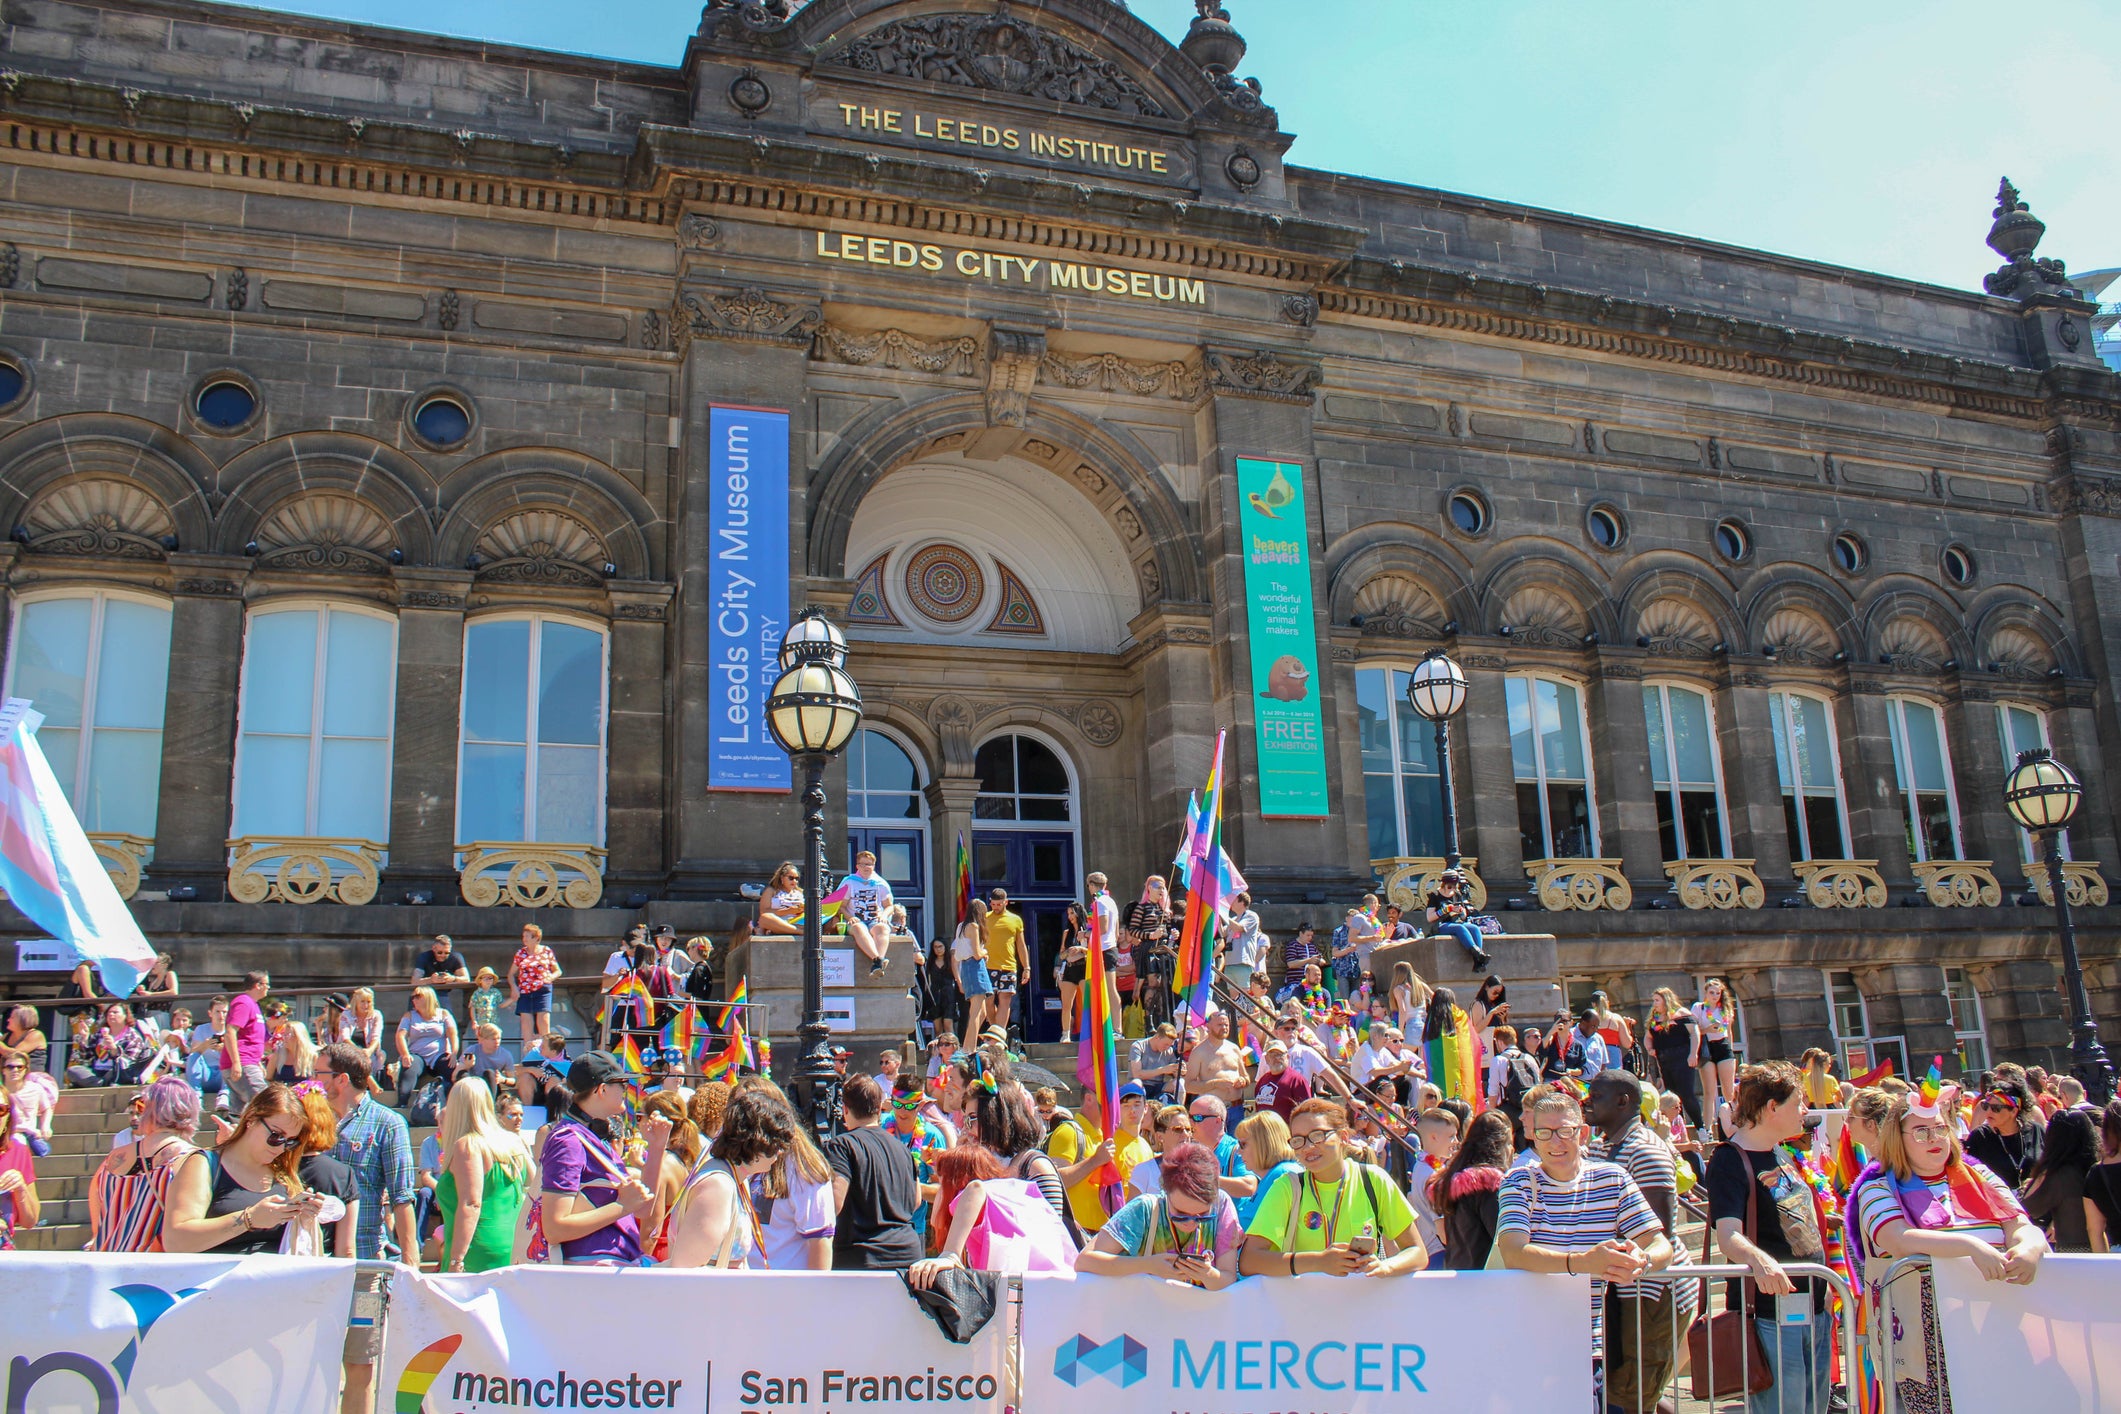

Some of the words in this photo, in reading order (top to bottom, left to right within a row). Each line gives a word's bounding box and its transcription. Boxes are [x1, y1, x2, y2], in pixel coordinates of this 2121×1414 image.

[838, 103, 902, 133] THE
[914, 114, 1020, 150] LEEDS
[1030, 132, 1168, 174] INSTITUTE
[817, 231, 944, 271] LEEDS
[955, 249, 1040, 284] CITY
[1050, 262, 1206, 305] MUSEUM
[719, 425, 749, 560] Museum
[1253, 533, 1300, 554] beavers
[1252, 552, 1300, 565] weavers
[1271, 581, 1288, 592] The
[718, 569, 757, 637] City
[1258, 593, 1302, 604] wonderful
[1262, 604, 1288, 614] world
[1291, 605, 1299, 614] of
[1267, 615, 1296, 625] animal
[1266, 626, 1299, 636] makers
[718, 646, 750, 744] Leeds
[1263, 720, 1317, 741] FREE
[1264, 741, 1318, 751] EXHIBITION
[1172, 1337, 1428, 1393] MERCER
[452, 1370, 682, 1408] manchester
[739, 1370, 808, 1405] San
[822, 1367, 998, 1404] Francisco
